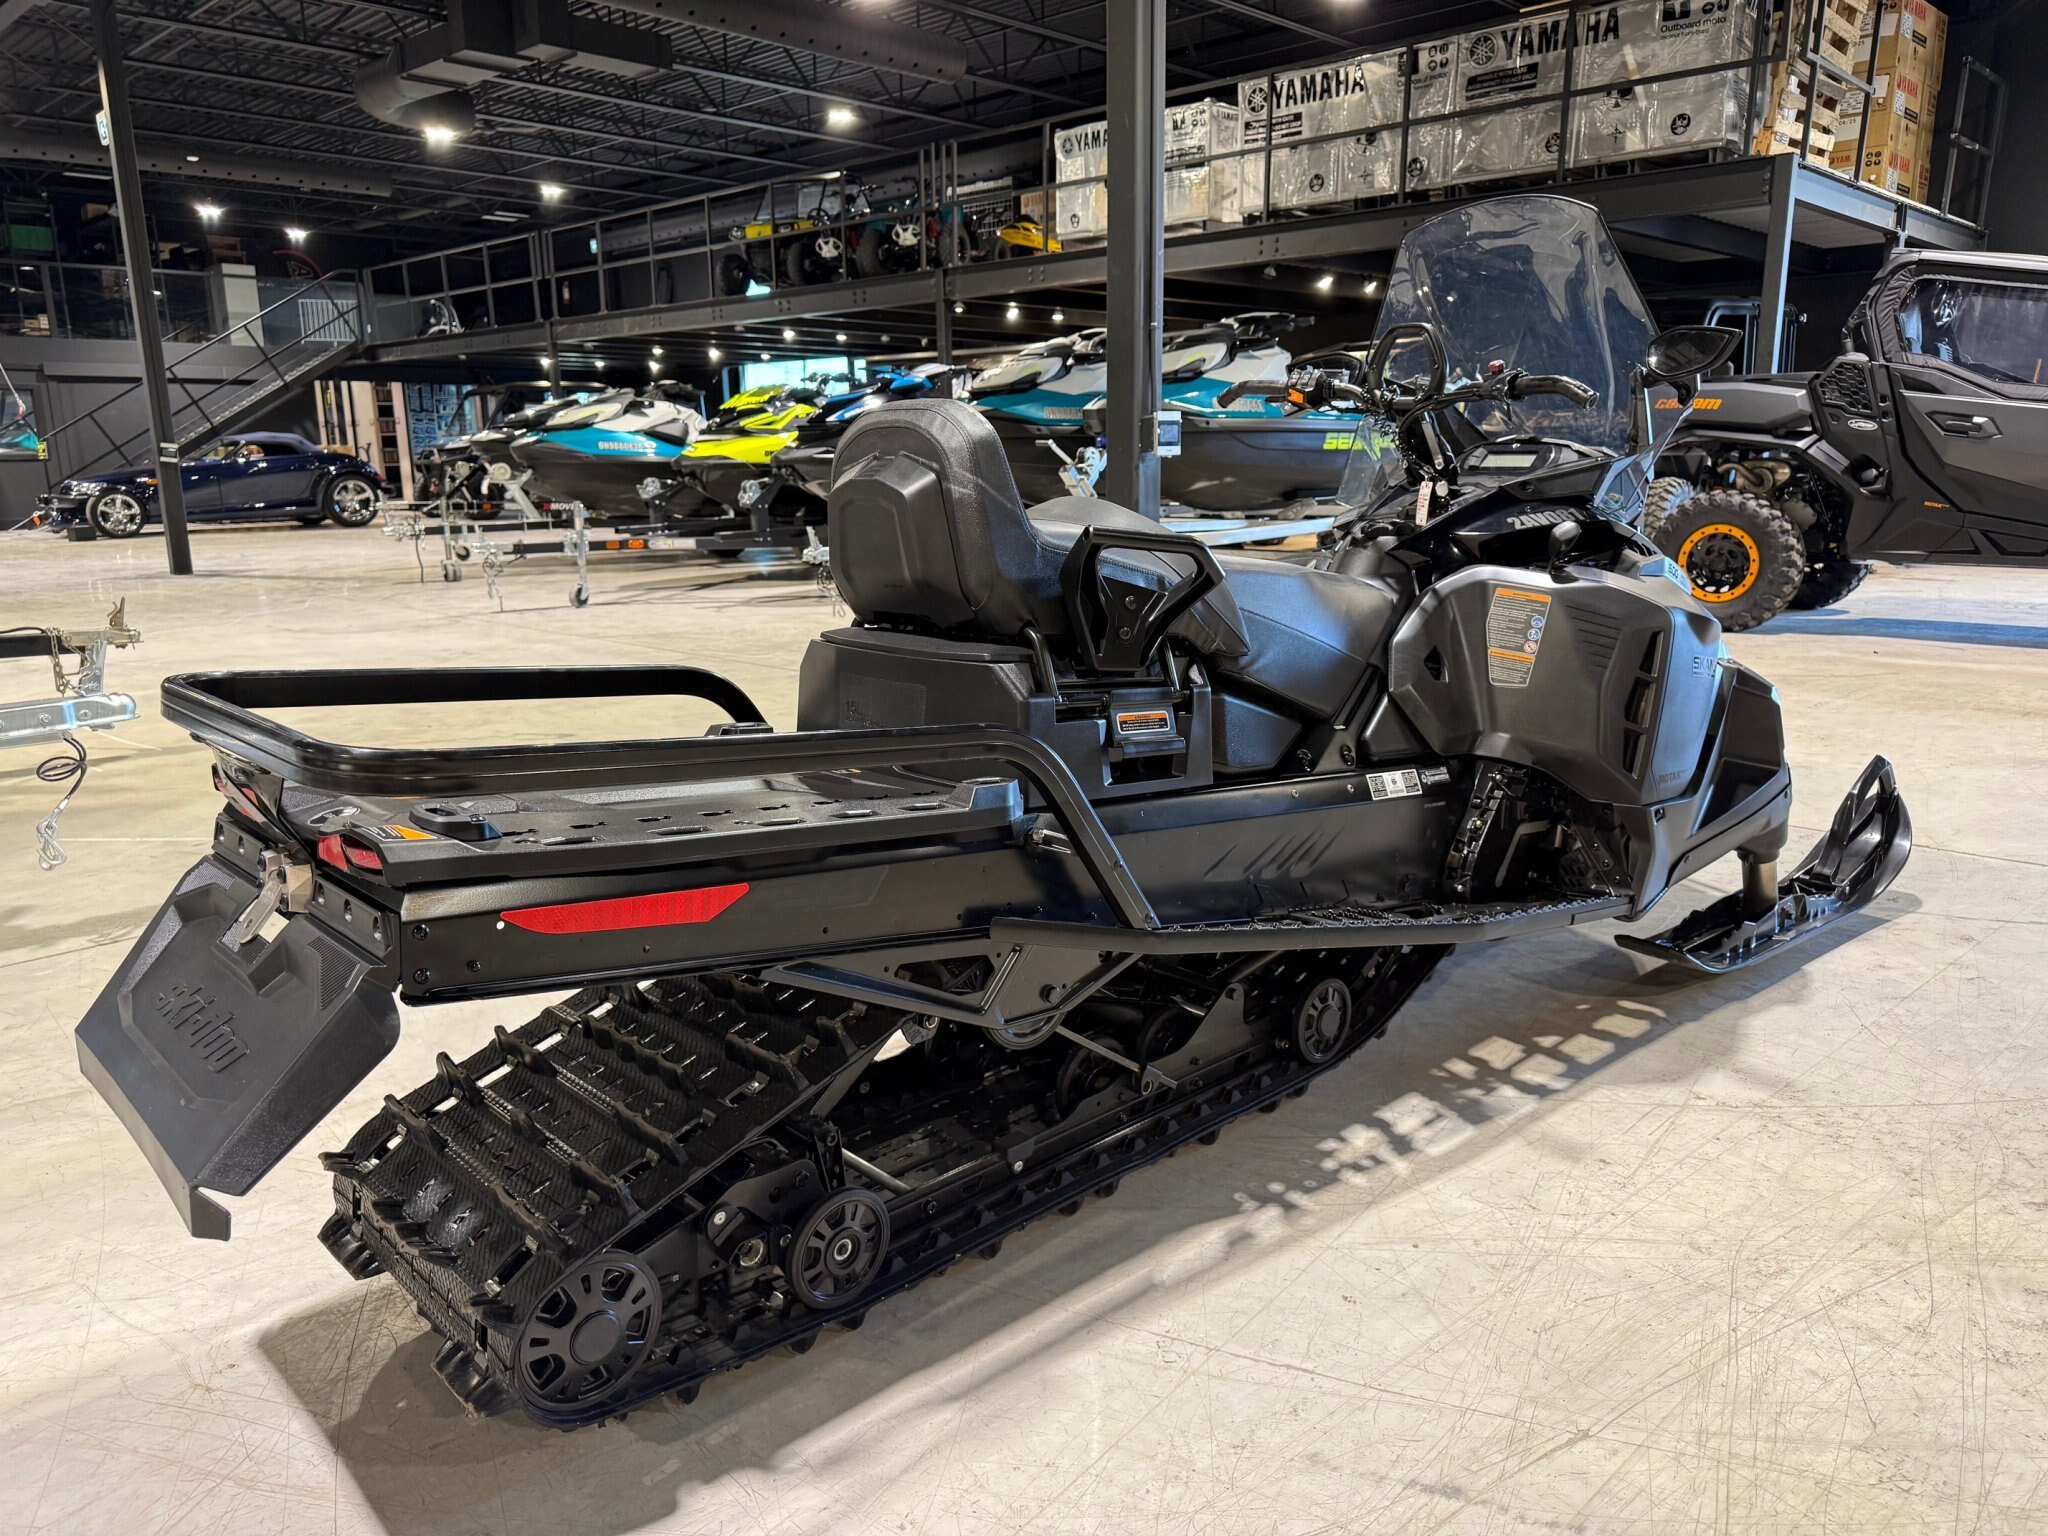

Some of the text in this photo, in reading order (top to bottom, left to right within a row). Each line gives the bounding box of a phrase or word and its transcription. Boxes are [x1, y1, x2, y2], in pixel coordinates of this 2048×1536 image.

[1501, 7, 1620, 61] YAMAHA
[1660, 19, 1701, 33] Outboard
[1272, 64, 1365, 109] YAMAHA
[1075, 130, 1108, 152] YAMA
[1655, 397, 1722, 410] caam
